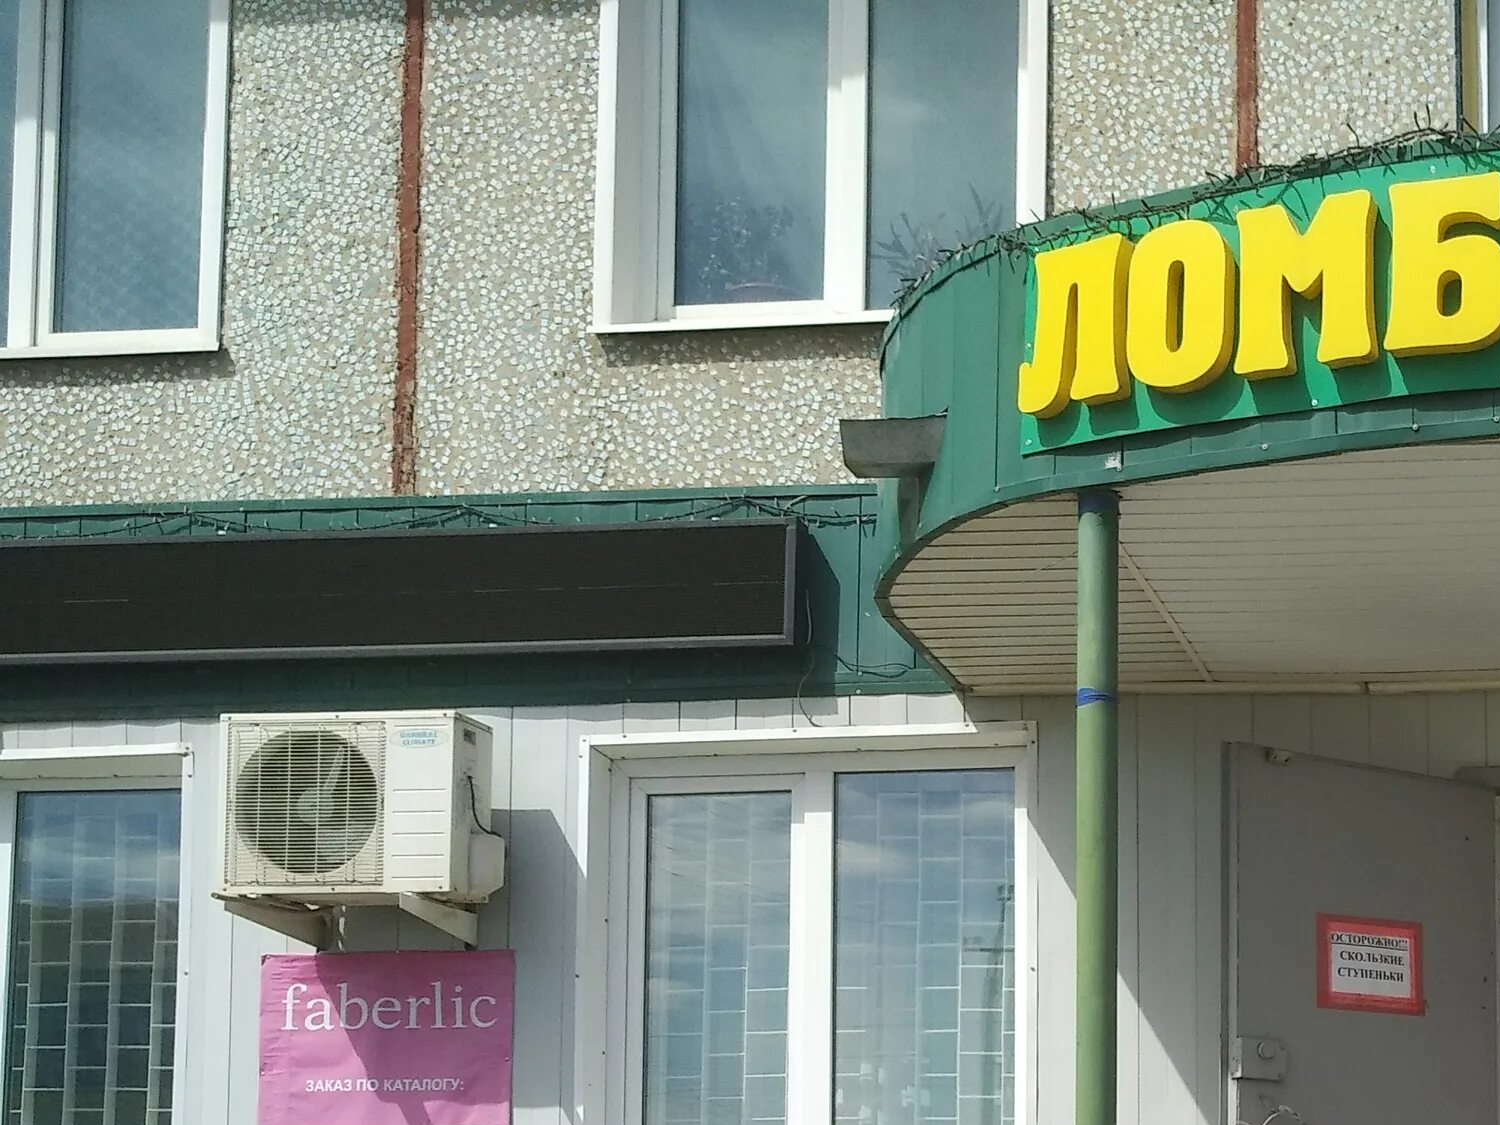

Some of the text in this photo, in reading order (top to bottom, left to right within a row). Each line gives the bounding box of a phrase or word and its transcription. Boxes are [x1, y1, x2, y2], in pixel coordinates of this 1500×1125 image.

[1340, 950, 1405, 966] СКОЛЬЗКИЕ
[1337, 966, 1404, 982] СТУПЕНЬКИ
[280, 980, 498, 1032] faberlic
[305, 1077, 465, 1092] ЗАКАЗ ПО КАТАЛОГУ:
